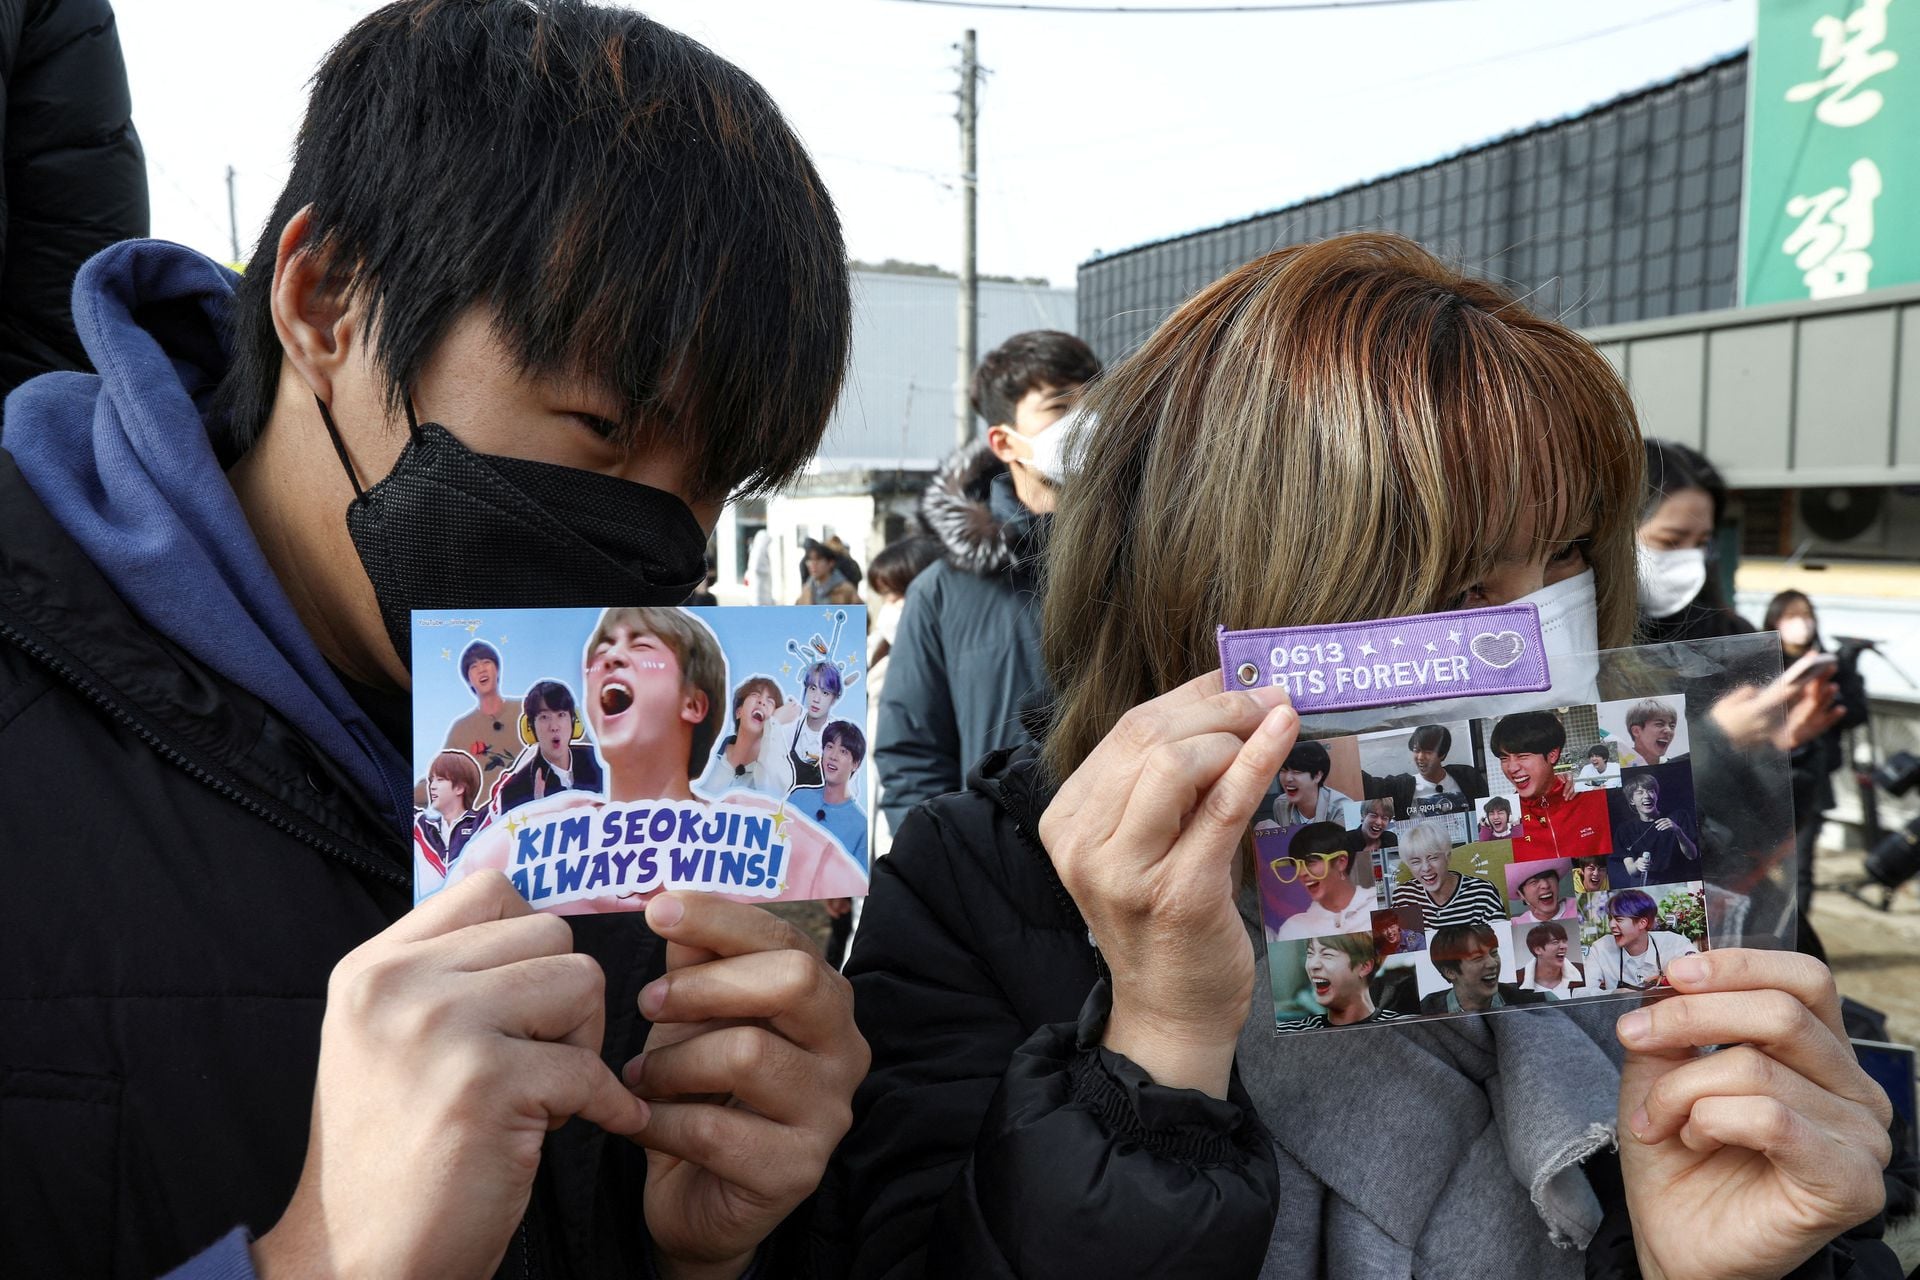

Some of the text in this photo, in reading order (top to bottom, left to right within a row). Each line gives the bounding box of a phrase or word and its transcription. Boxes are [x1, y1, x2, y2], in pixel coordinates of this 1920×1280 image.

[1270, 642, 1346, 668] 0613
[1271, 655, 1471, 696] BTS FOREVER
[516, 807, 772, 865] KIM SEOKJIN
[511, 844, 784, 901] ALWAYS WINS!
